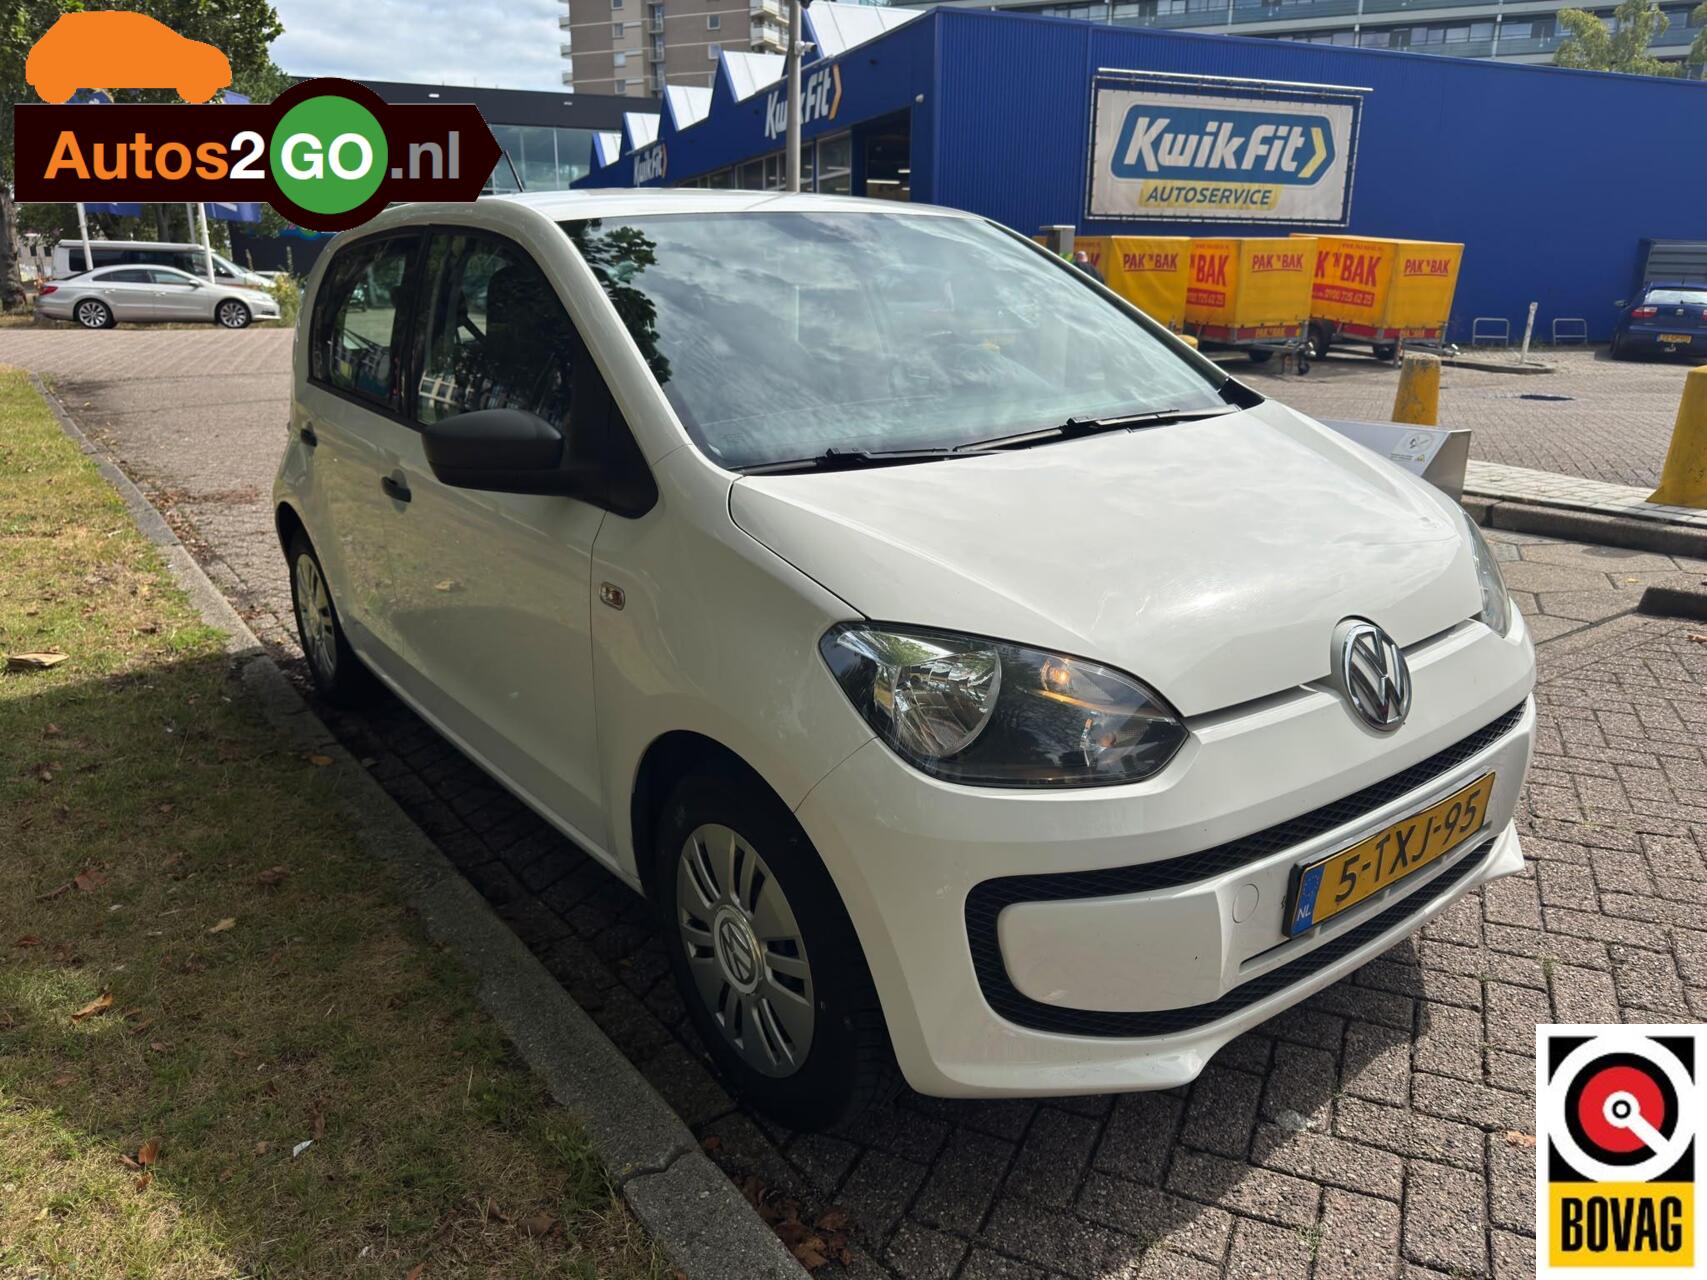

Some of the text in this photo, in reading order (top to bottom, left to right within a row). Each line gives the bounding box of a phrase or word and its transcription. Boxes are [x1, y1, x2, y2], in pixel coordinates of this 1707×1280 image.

[1146, 186, 1272, 205] AUTOSERVICE
[1123, 253, 1146, 269] PAK
[1155, 253, 1178, 269] BAK
[1196, 254, 1229, 287] BAK
[1252, 254, 1274, 269] PAK
[1281, 254, 1304, 269] BAK
[1340, 253, 1382, 287] BAK
[1404, 259, 1424, 273] PAK
[1430, 259, 1450, 274] BAK
[1296, 789, 1480, 921] NL 5-TXJ-95
